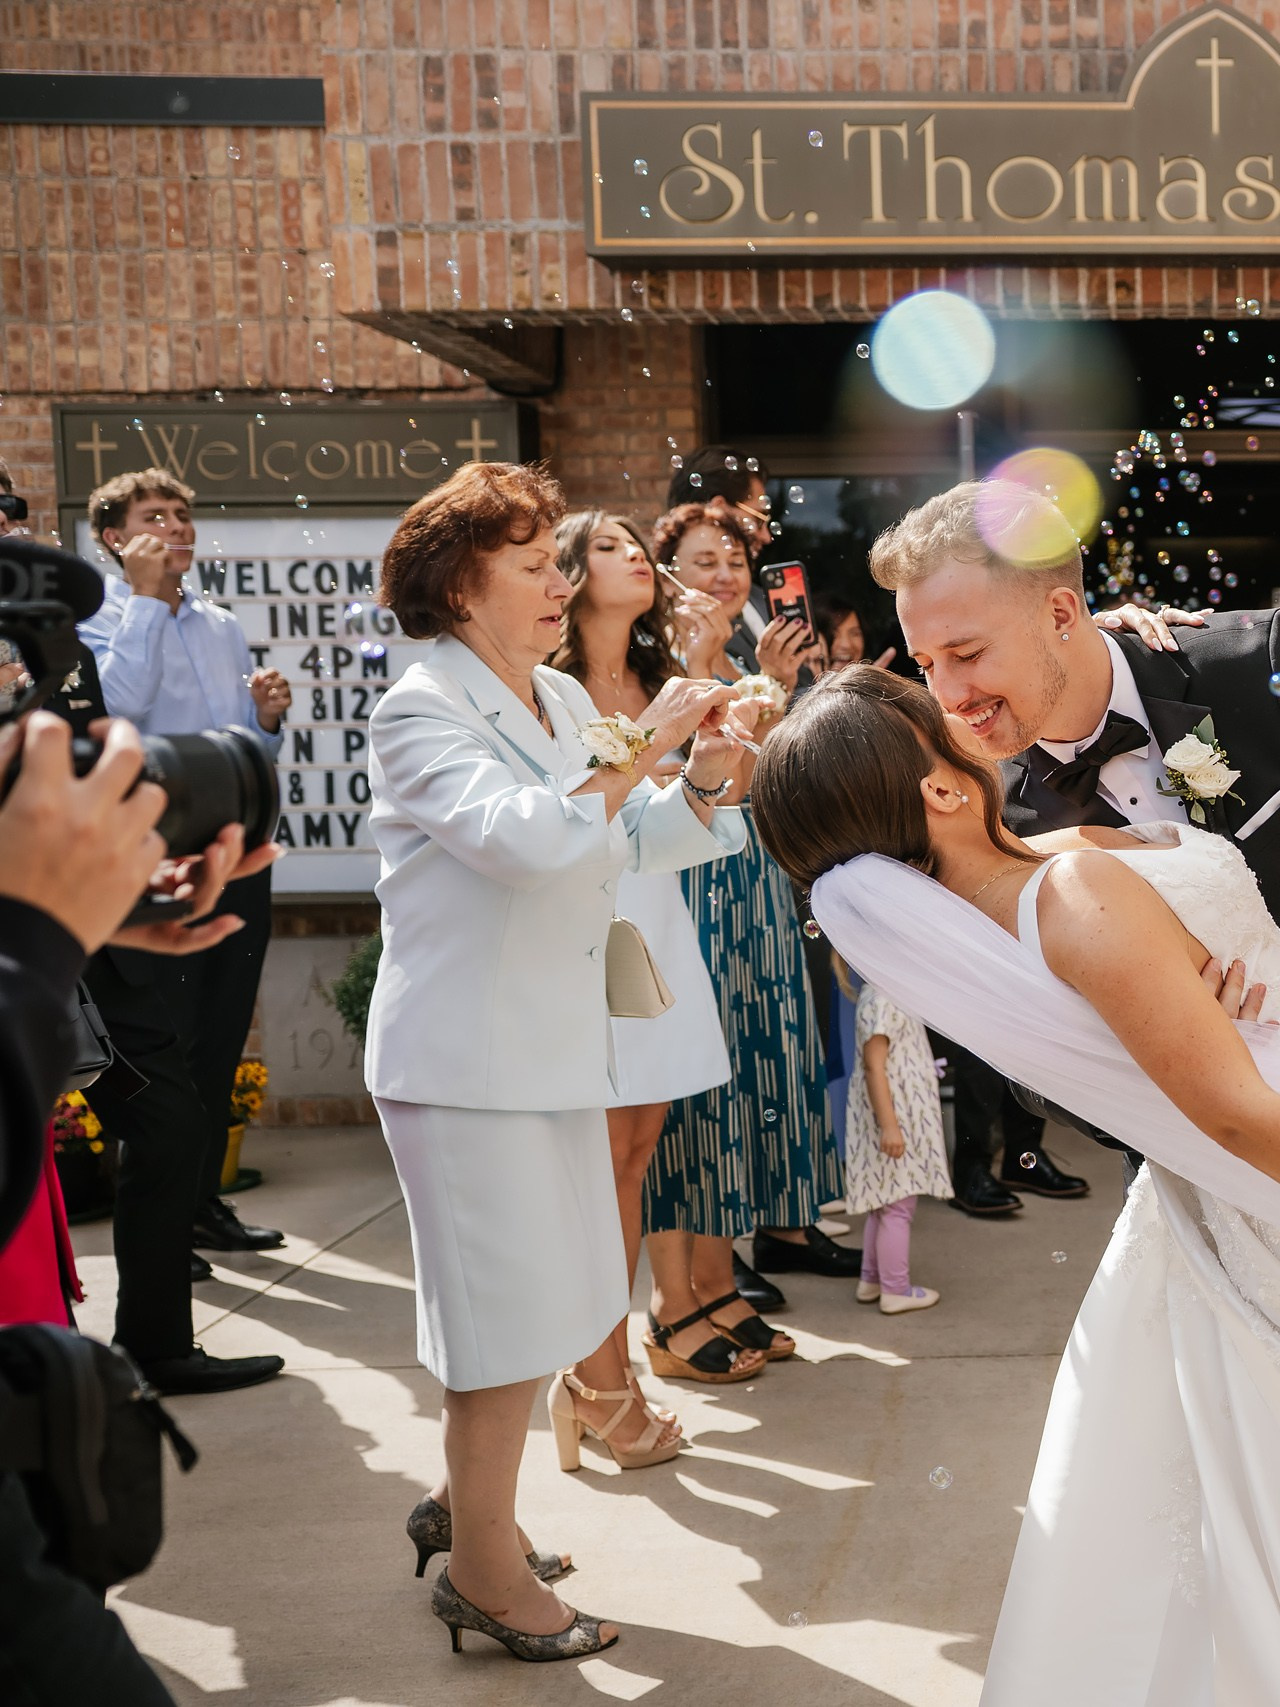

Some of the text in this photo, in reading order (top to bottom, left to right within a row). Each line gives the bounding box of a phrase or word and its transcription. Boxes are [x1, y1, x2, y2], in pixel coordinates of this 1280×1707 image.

[659, 121, 820, 226] St.
[137, 419, 446, 481] Welcome
[197, 560, 374, 595] WELCOM
[269, 603, 406, 638] INENG
[300, 645, 388, 679] 4PM
[275, 812, 361, 848] AMY
